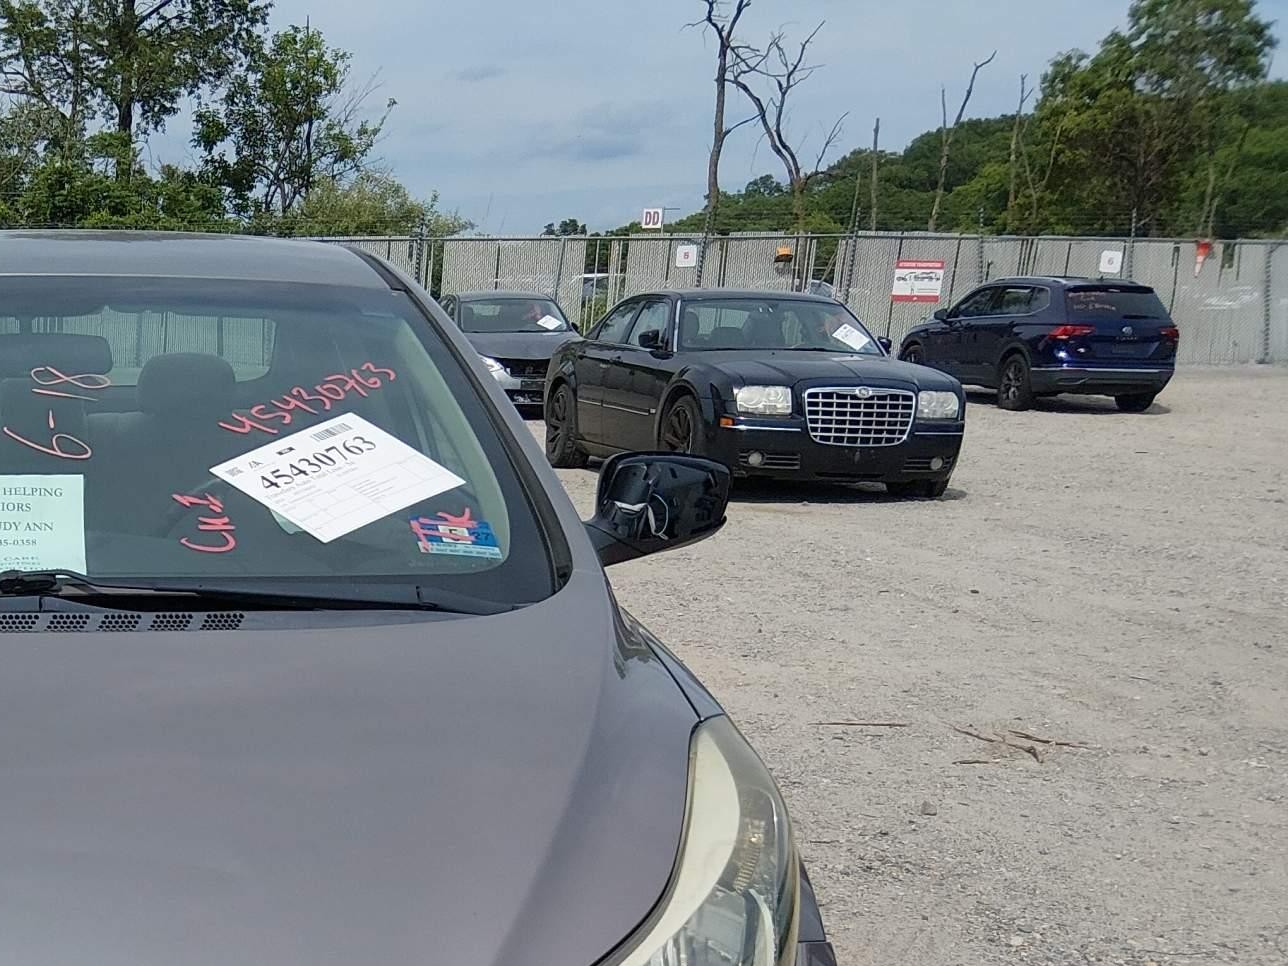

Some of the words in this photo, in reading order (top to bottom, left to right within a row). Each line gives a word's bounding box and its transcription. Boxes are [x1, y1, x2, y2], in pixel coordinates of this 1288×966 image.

[644, 211, 660, 226] DD
[217, 362, 396, 434] 45430763
[260, 435, 377, 489] 45430763
[3, 486, 63, 497] HELPING
[24, 522, 54, 532] ANN
